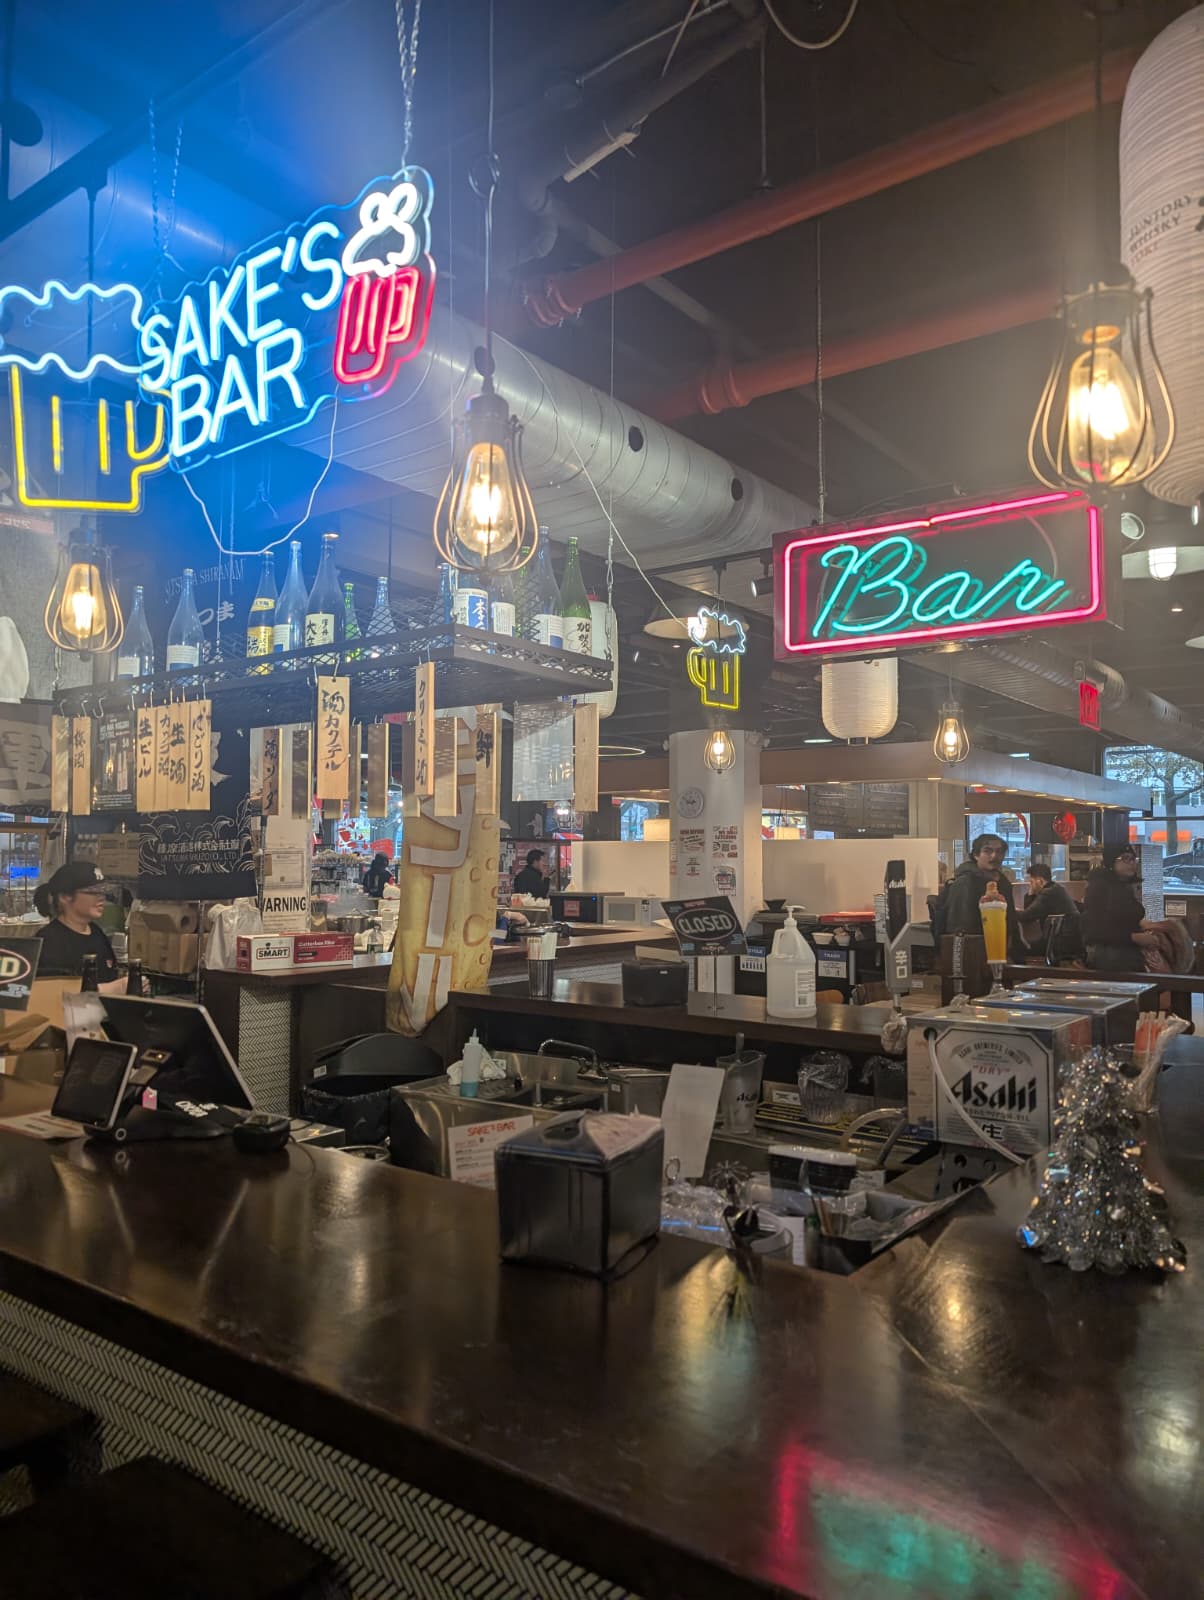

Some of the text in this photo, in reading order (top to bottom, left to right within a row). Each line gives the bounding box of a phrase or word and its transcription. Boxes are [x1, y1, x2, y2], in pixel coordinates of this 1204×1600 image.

[140, 221, 345, 391] SAKE'S
[171, 327, 305, 458] BAR
[811, 534, 1066, 638] Bar
[577, 622, 592, 655] 加賀
[138, 716, 153, 778] 生ビール
[169, 722, 186, 784] 生酒
[255, 896, 307, 913] WARNING
[678, 913, 733, 934] CLOSED
[258, 949, 288, 958] SMART
[946, 1070, 1037, 1113] Asahi
